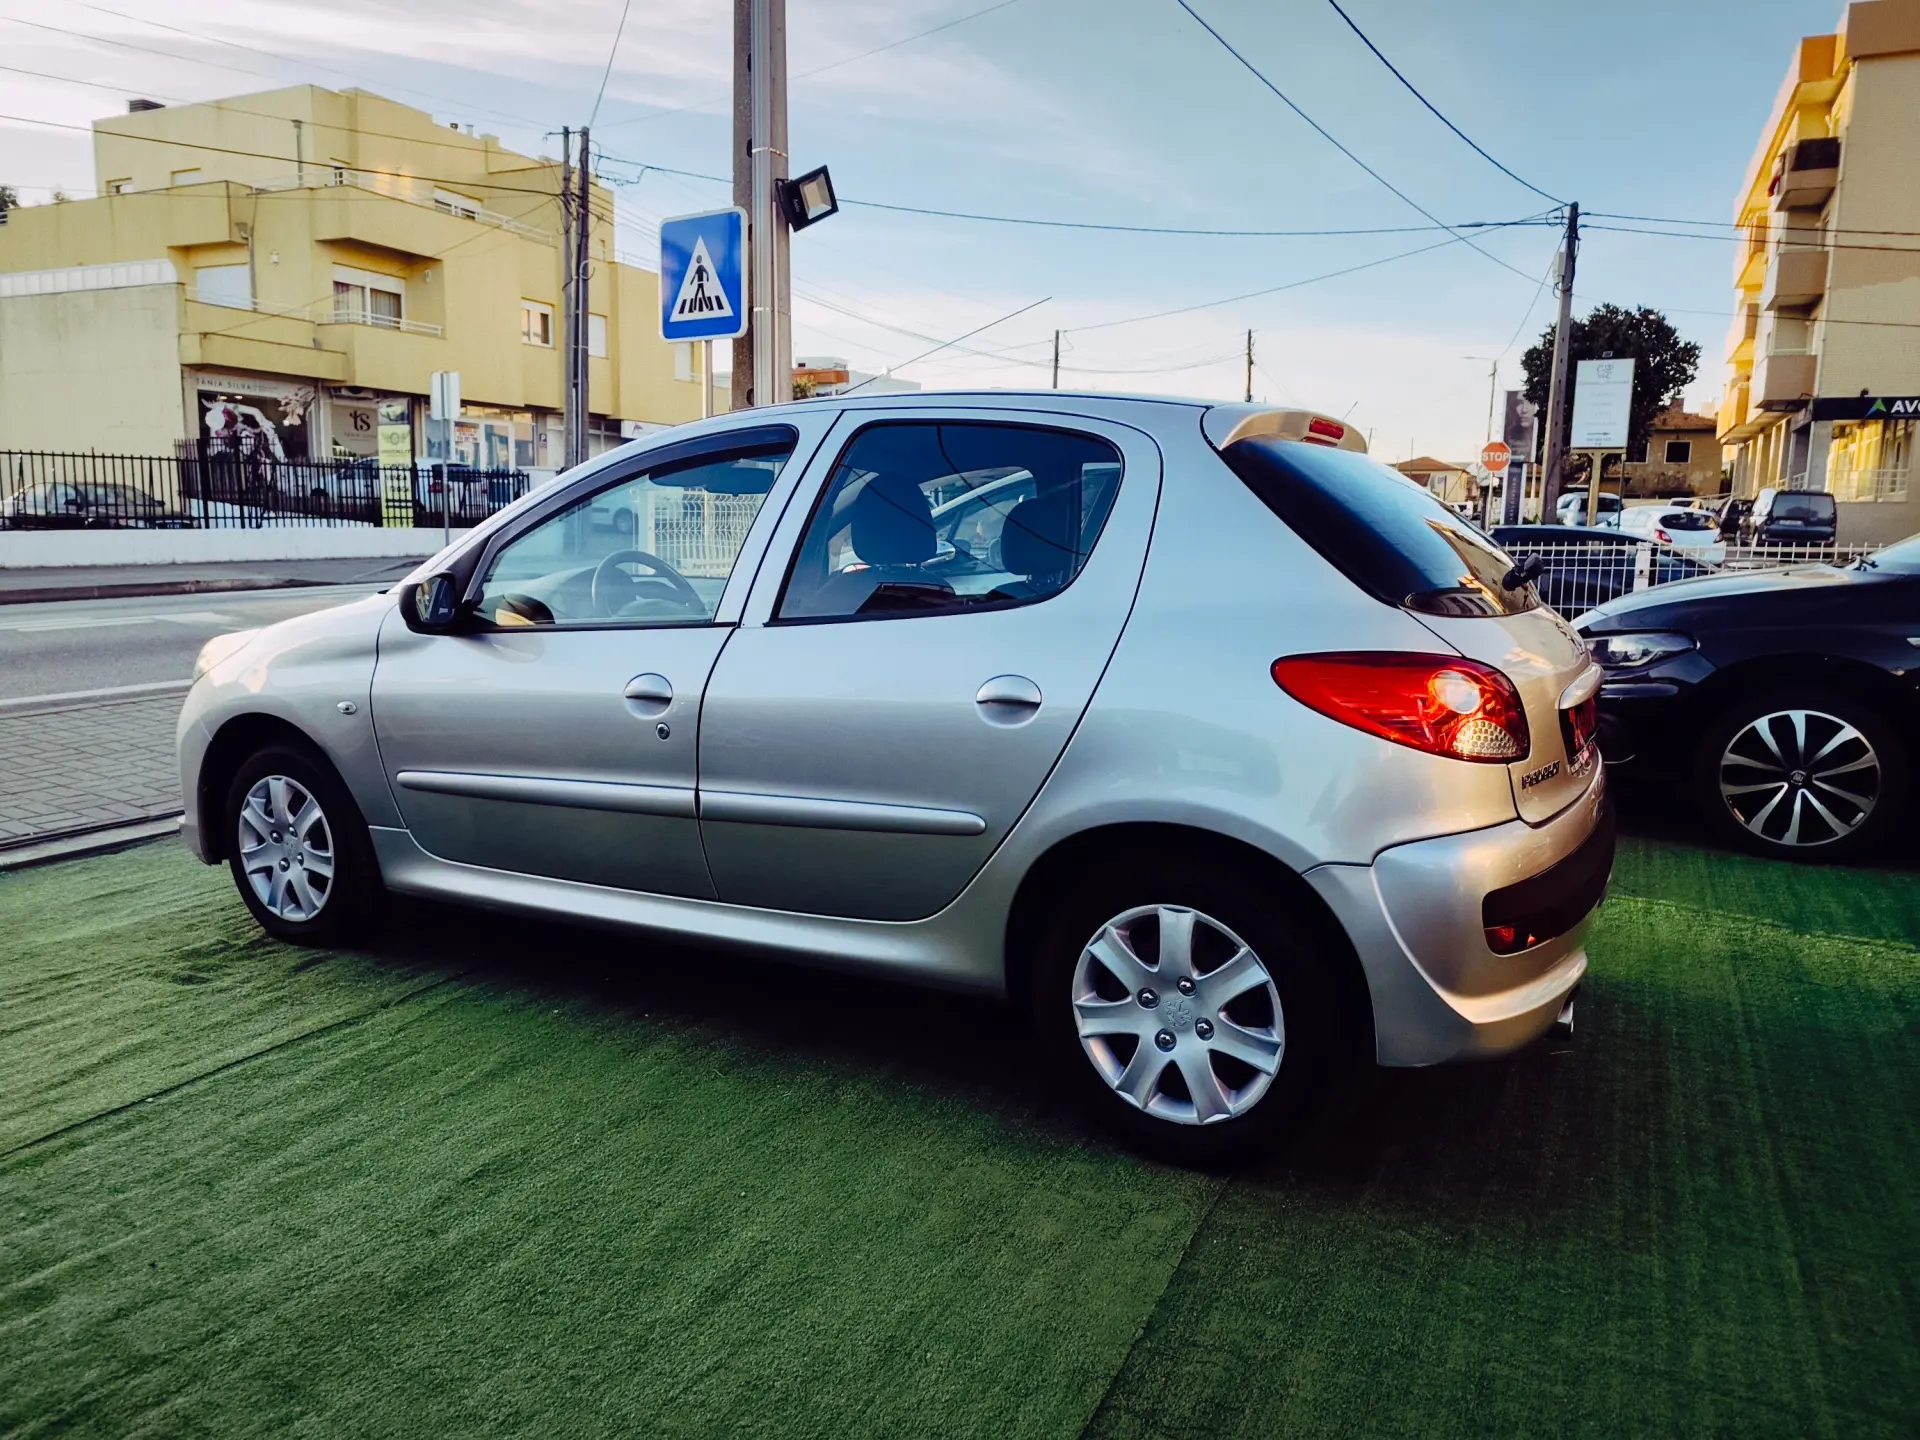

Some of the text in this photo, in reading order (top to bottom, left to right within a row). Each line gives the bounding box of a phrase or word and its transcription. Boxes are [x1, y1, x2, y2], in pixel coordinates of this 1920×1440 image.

[227, 382, 252, 390] SILVA
[1891, 400, 1920, 413] AV
[1482, 451, 1509, 462] STOP
